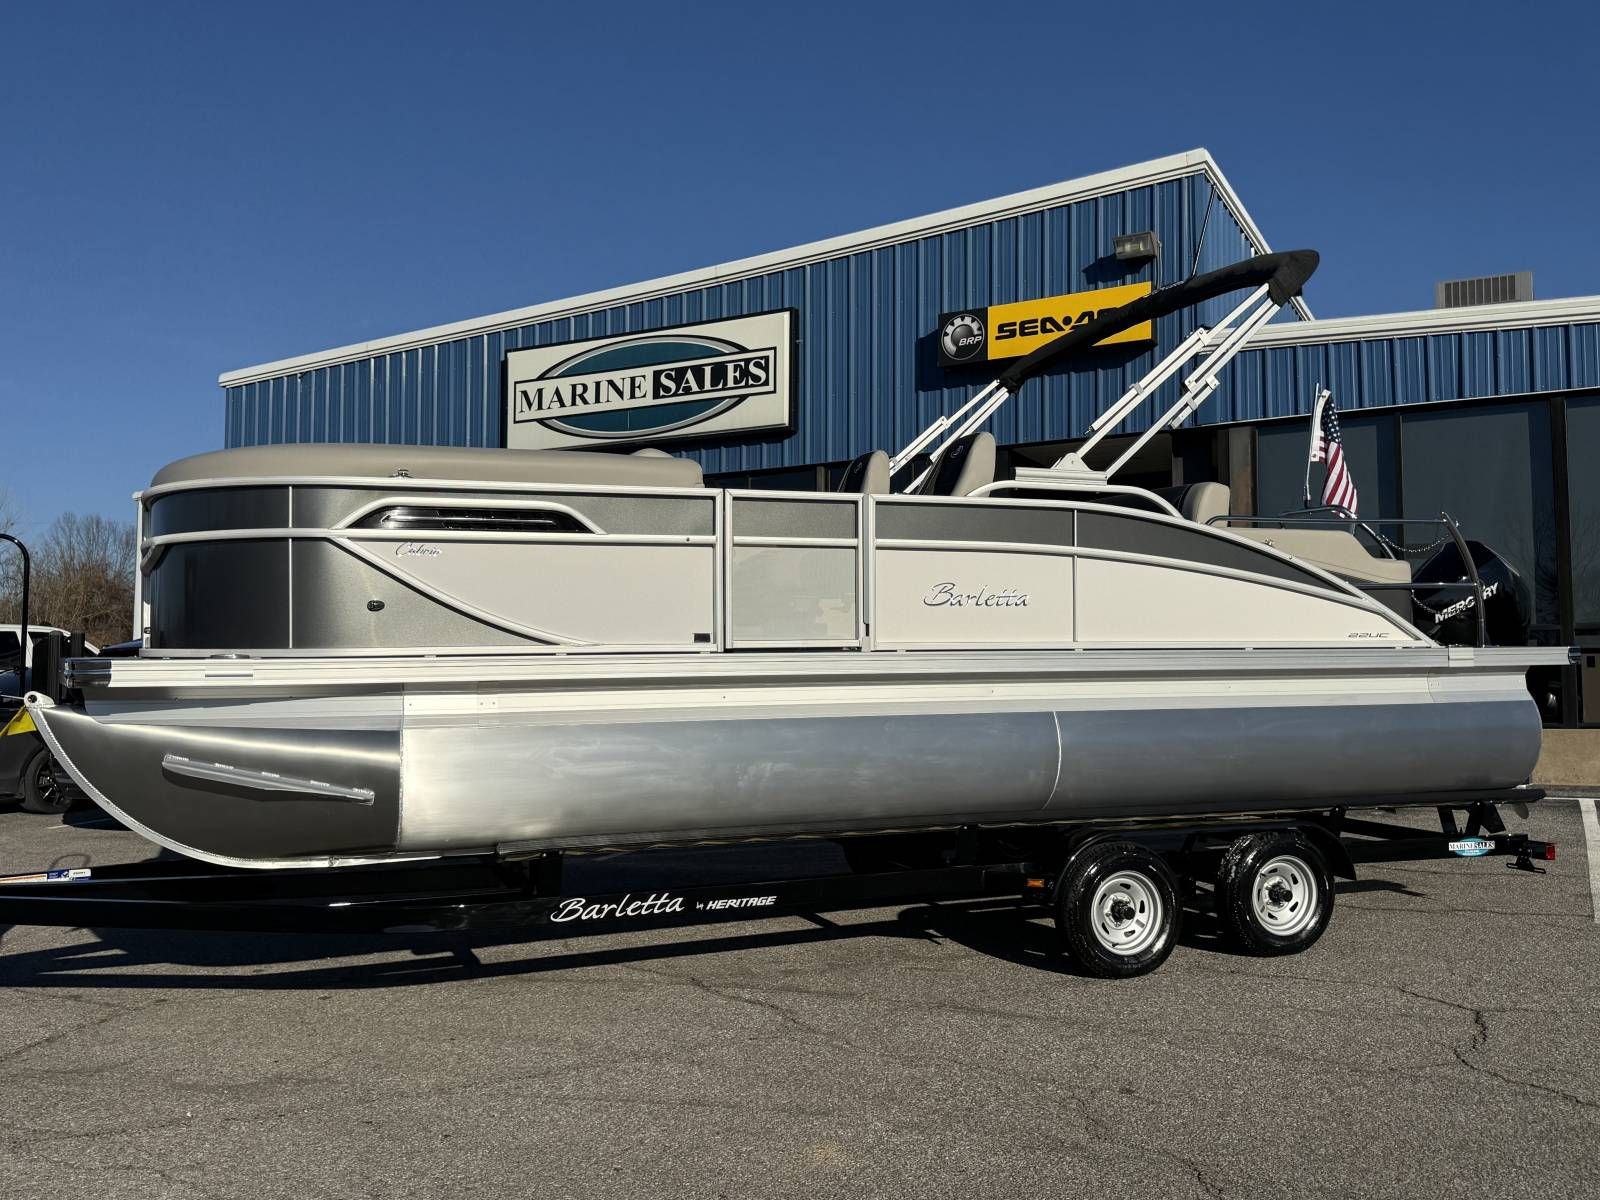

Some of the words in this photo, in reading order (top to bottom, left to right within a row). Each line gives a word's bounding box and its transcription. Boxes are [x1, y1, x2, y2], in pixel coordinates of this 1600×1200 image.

[958, 335, 982, 347] BRP
[518, 374, 648, 414] MARINE
[659, 357, 768, 397] SALES
[923, 582, 1029, 607] Barletta
[1434, 582, 1499, 624] MERCRY
[550, 893, 685, 922] Barletta
[706, 896, 778, 910] HERITAGE
